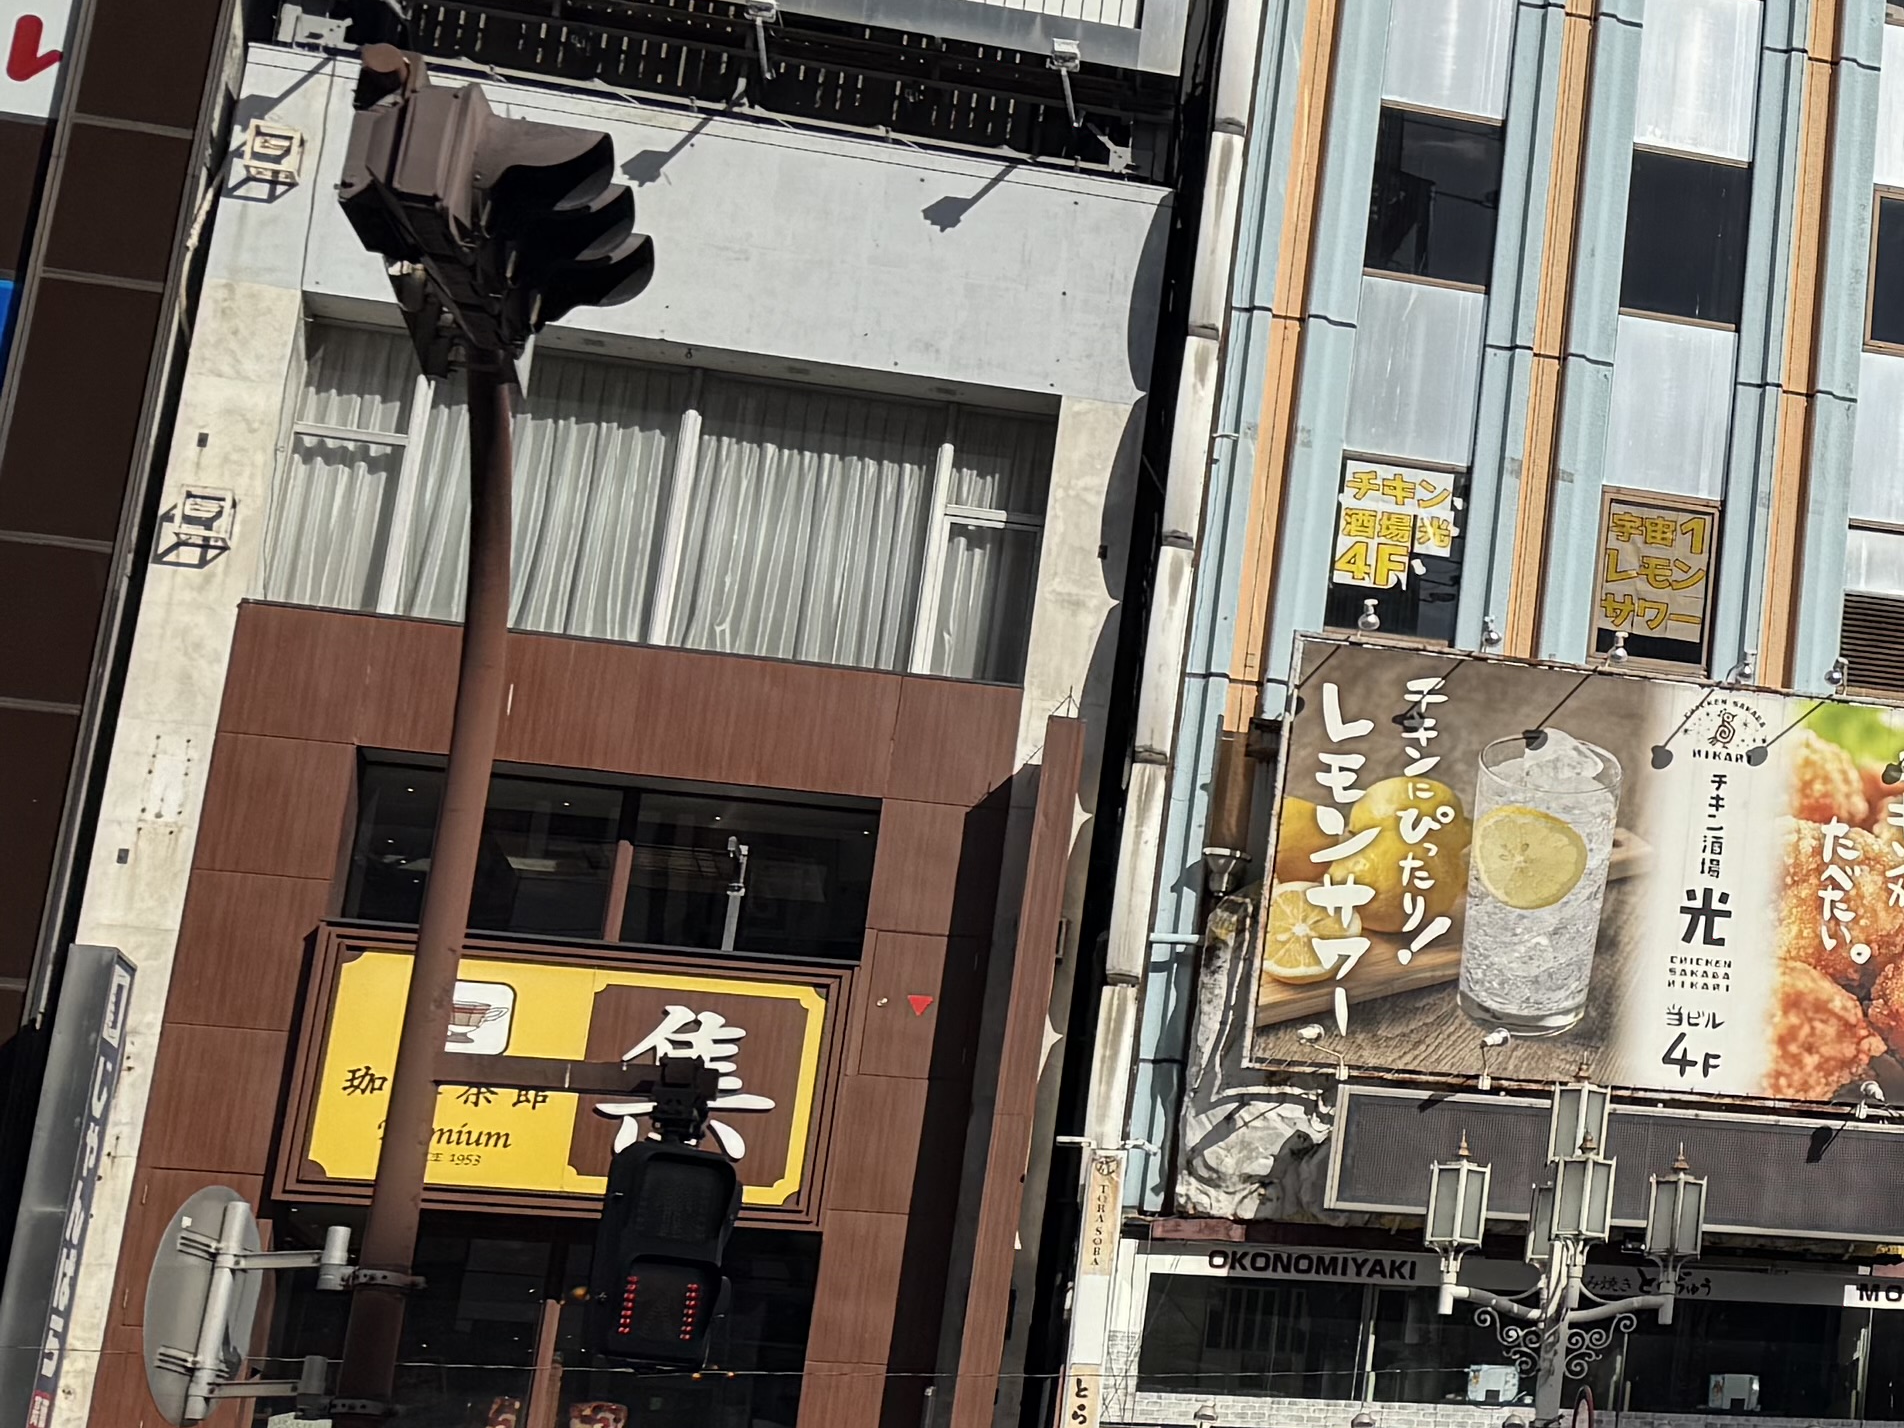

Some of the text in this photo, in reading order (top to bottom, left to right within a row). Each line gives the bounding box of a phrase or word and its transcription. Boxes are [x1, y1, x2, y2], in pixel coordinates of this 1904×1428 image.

[1345, 469, 1453, 510] チキン
[1341, 506, 1453, 550] 酒場光
[1334, 539, 1411, 586] 4F
[1604, 547, 1707, 591] レモン
[1599, 592, 1702, 631] サワー
[1700, 773, 1728, 879] チキン酒場
[1305, 681, 1383, 1036] レモンサワー
[1819, 816, 1871, 968] たべたい。
[1678, 885, 1733, 949] 光
[1663, 1002, 1725, 1031] 当ビル
[1662, 1031, 1721, 1080] 4F
[340, 1064, 550, 1111] 珈茶館
[593, 1003, 777, 1162] 集
[447, 1150, 483, 1168] 1953
[1207, 1247, 1419, 1283] OKONOMIYAKI
